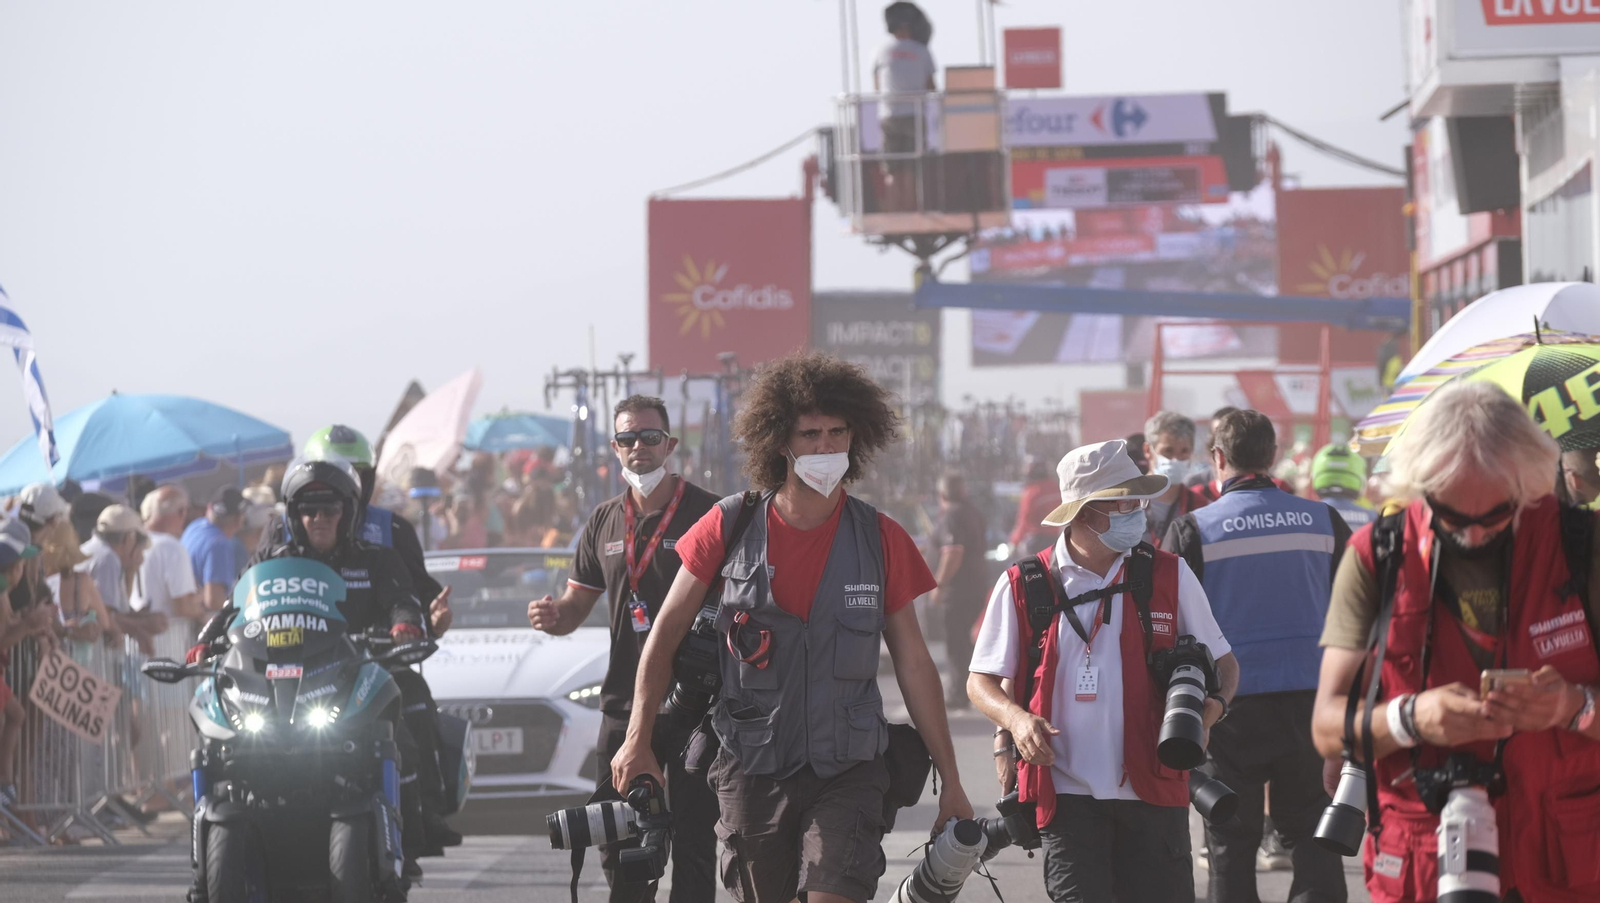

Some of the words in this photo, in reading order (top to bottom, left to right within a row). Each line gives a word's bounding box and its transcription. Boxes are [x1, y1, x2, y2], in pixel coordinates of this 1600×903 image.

[1328, 272, 1410, 299] Cofid
[691, 283, 794, 310] Cofidis
[1222, 511, 1313, 532] COMISARIO
[258, 577, 329, 597] caser
[844, 584, 879, 592] SHIMANO
[281, 596, 330, 612] Helvetia
[262, 613, 329, 632] YAMAHA
[1528, 610, 1586, 637] SHIMANO
[269, 632, 301, 647] META
[1540, 638, 1556, 653] LA
[45, 652, 97, 704] SOS
[35, 678, 104, 737] SALINAS
[477, 731, 517, 751] LPT
